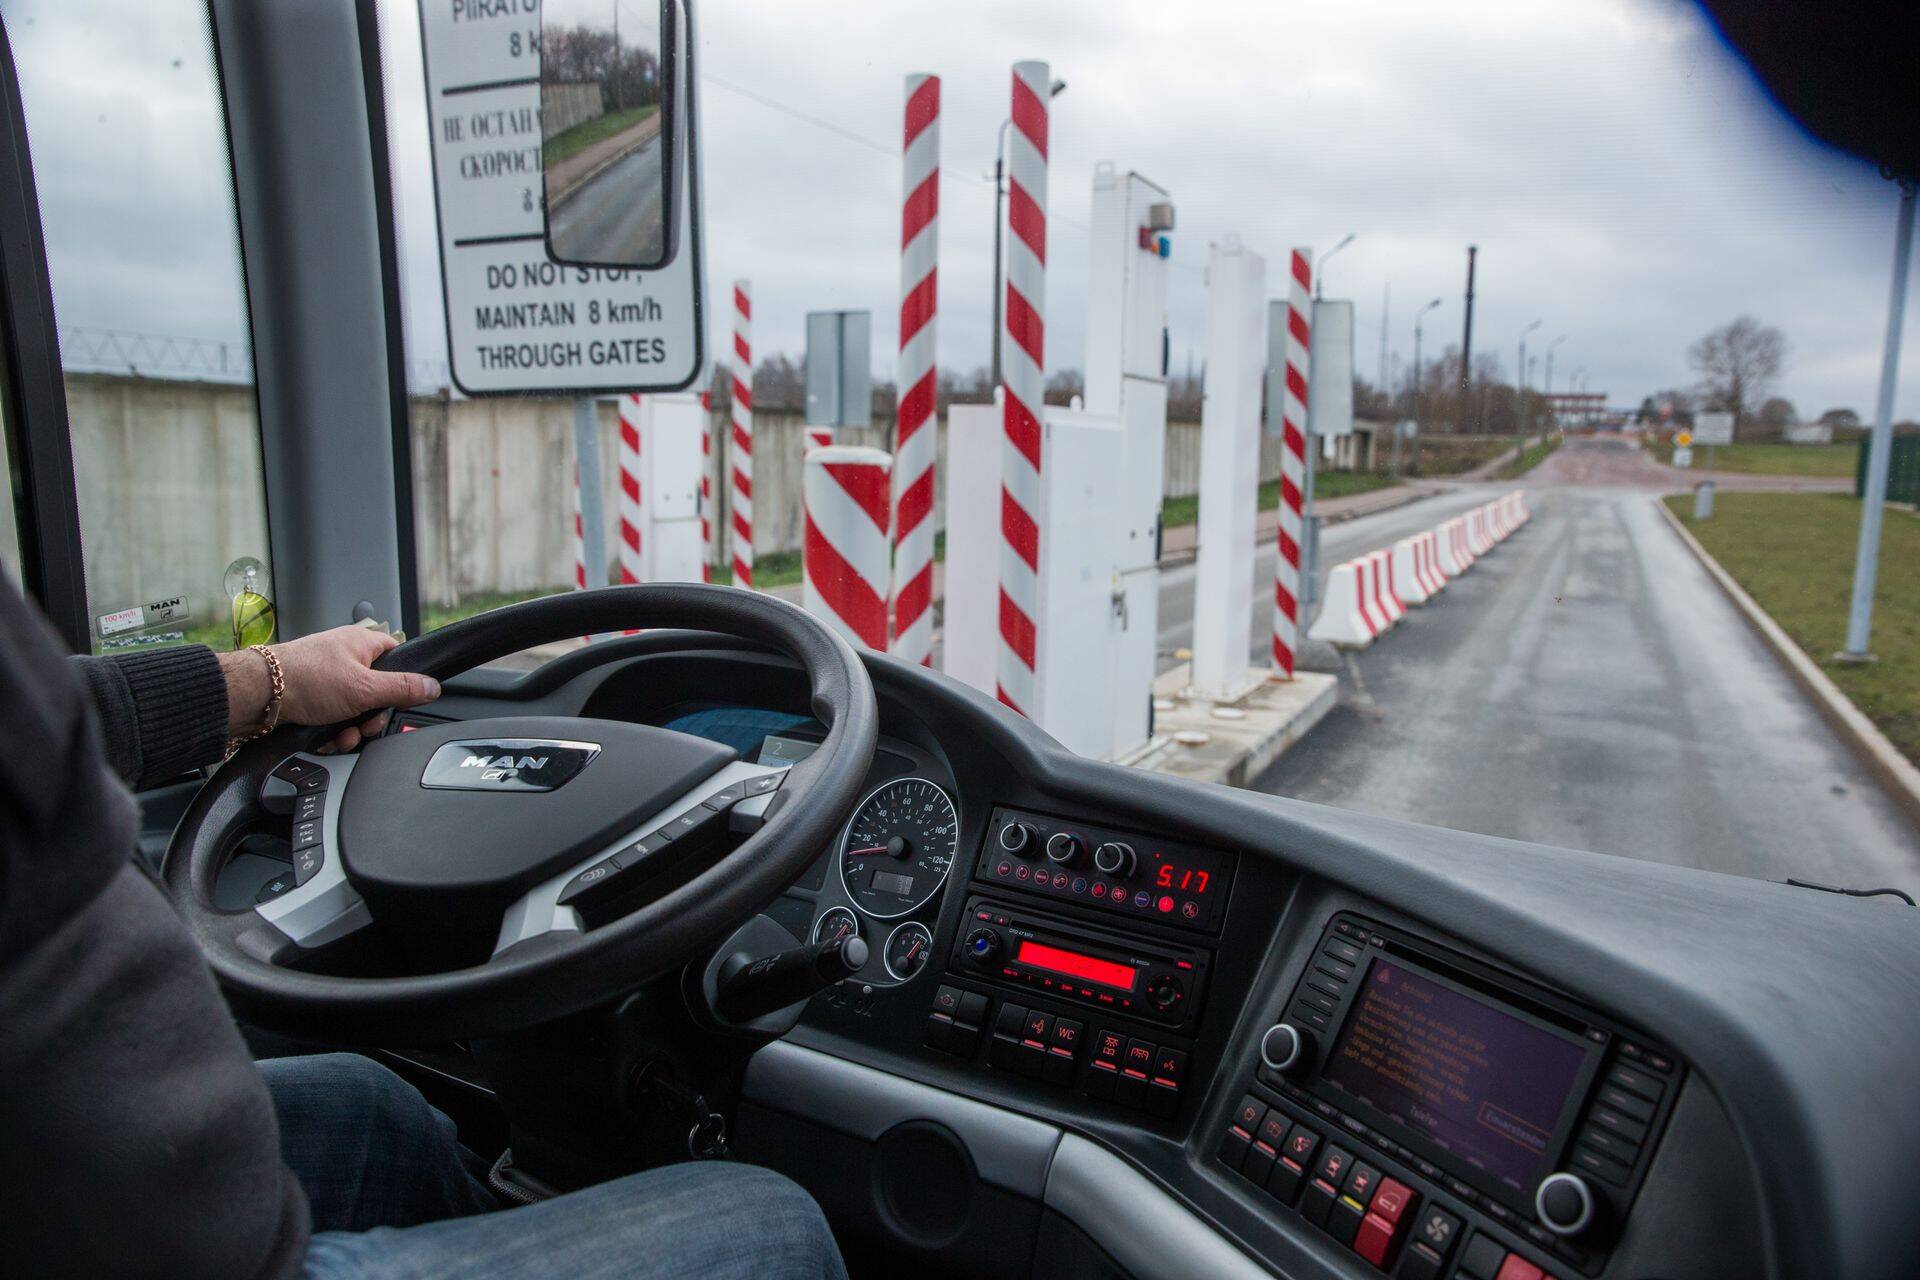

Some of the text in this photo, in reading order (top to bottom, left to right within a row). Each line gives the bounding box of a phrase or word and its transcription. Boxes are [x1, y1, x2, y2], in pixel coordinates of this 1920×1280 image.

[509, 31, 522, 57] 8
[442, 114, 465, 143] НЕ
[486, 263, 518, 291] DO
[523, 259, 566, 288] NOT
[475, 296, 663, 331] MAINTAIN 8 km/h
[477, 338, 666, 370] THROUGH GATES
[150, 599, 180, 611] MAN
[104, 614, 118, 623] 100
[772, 742, 783, 756] 2
[460, 755, 549, 769] MAN
[924, 804, 933, 812] 80
[863, 833, 871, 842] 20
[934, 826, 947, 835] 100
[858, 863, 864, 871] 0
[932, 856, 944, 864] 120
[1058, 1027, 1075, 1041] WC
